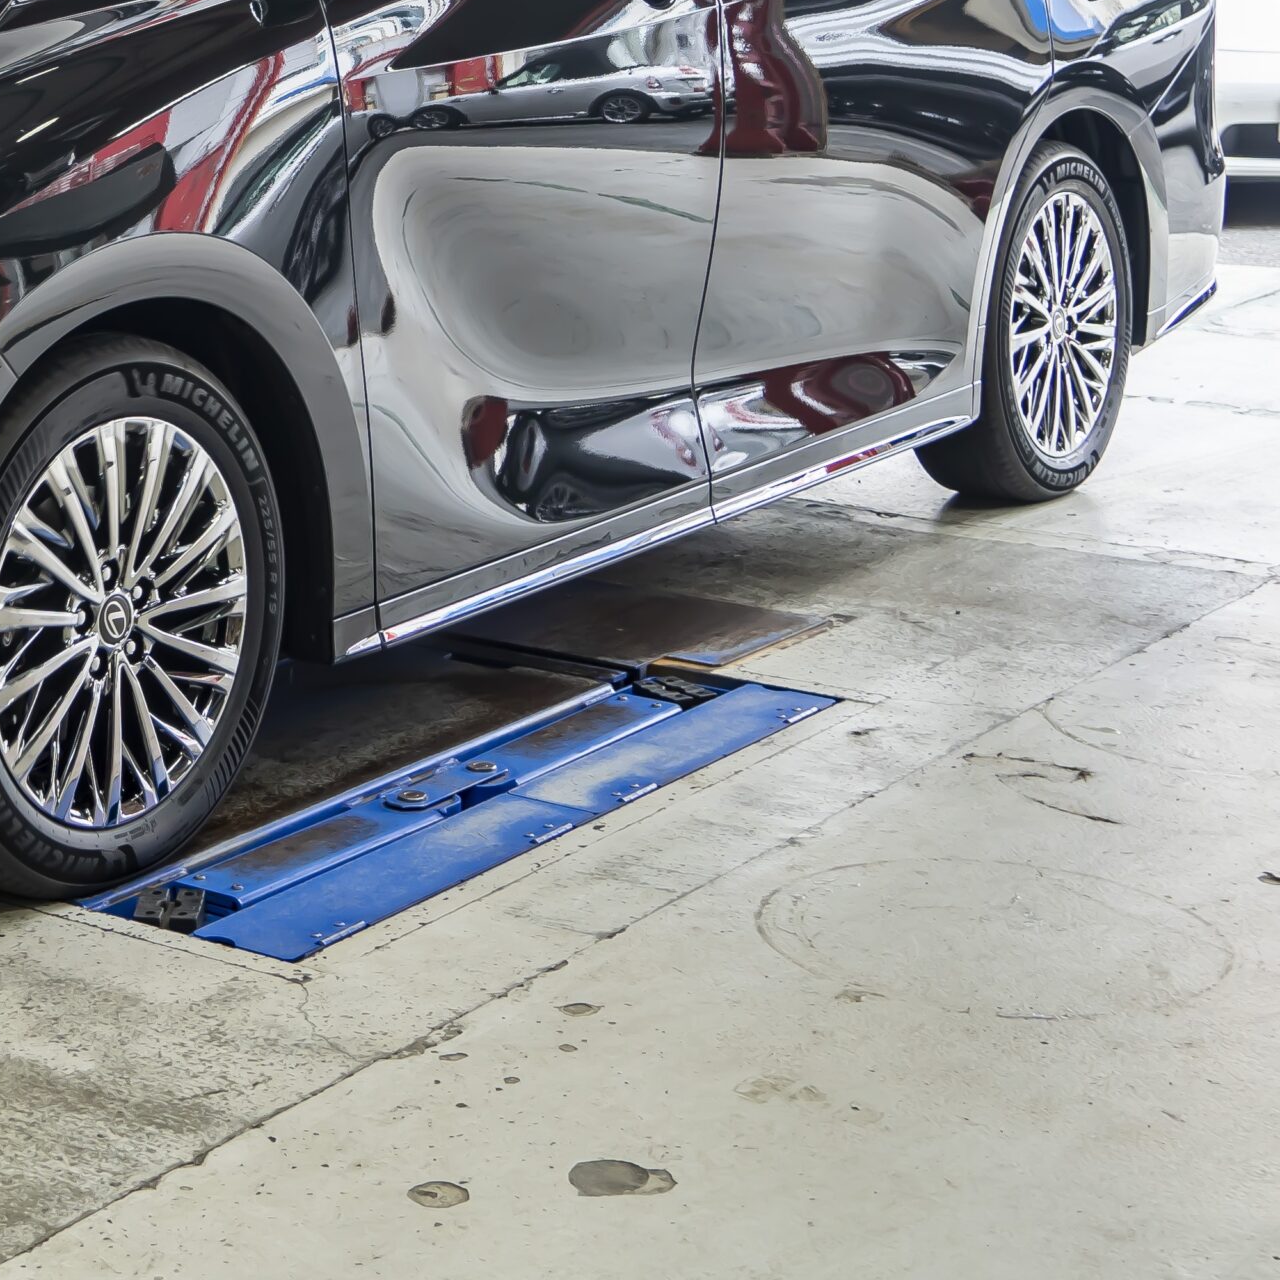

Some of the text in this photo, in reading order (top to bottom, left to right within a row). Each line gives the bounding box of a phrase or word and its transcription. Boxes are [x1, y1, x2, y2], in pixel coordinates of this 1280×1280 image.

[1056, 162, 1106, 194] MICHELIN
[160, 373, 259, 471] MICHELIN
[1032, 461, 1087, 487] MICHELIN
[258, 495, 278, 563] 225/55
